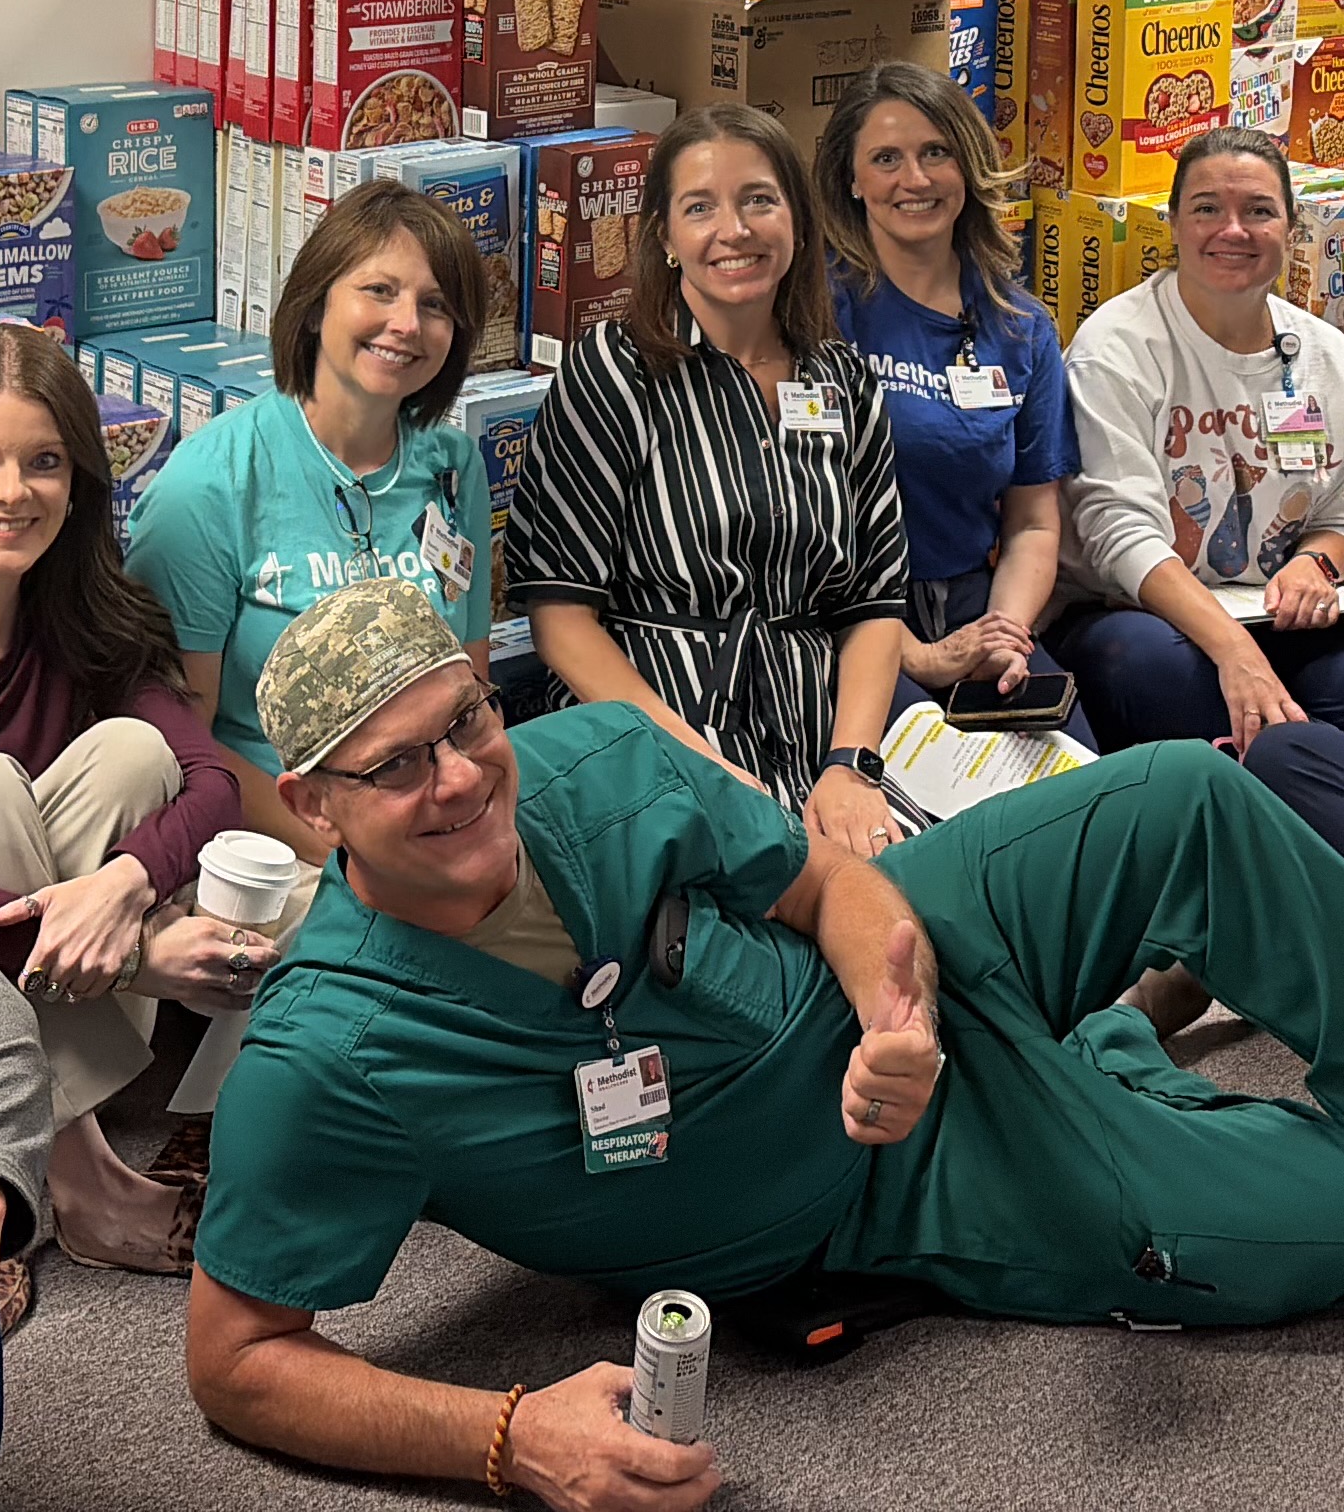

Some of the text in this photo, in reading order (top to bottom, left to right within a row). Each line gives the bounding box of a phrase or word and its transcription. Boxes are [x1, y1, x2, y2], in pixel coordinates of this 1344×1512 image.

[912, 9, 939, 22] 16968
[370, 28, 400, 38] PROVIDES
[407, 25, 436, 34] ESSENTIAL
[712, 20, 734, 32] 16968
[1141, 22, 1220, 56] Cheerios
[1086, 4, 1111, 106] Cheerios
[1157, 54, 1214, 70] 100% OATS
[112, 135, 174, 150] CRISPY
[1140, 122, 1209, 146] LOWER CHOLESTEROL
[108, 146, 177, 177] RICE
[617, 164, 638, 172] H-E-B
[102, 286, 184, 304] A FAT FREE FOOD
[869, 354, 948, 391] Metho
[879, 380, 932, 400] OSPITAL
[598, 1068, 637, 1086] Methodist
[592, 1131, 652, 1152] RESPIRATOR
[604, 1148, 647, 1165] THERAPY
